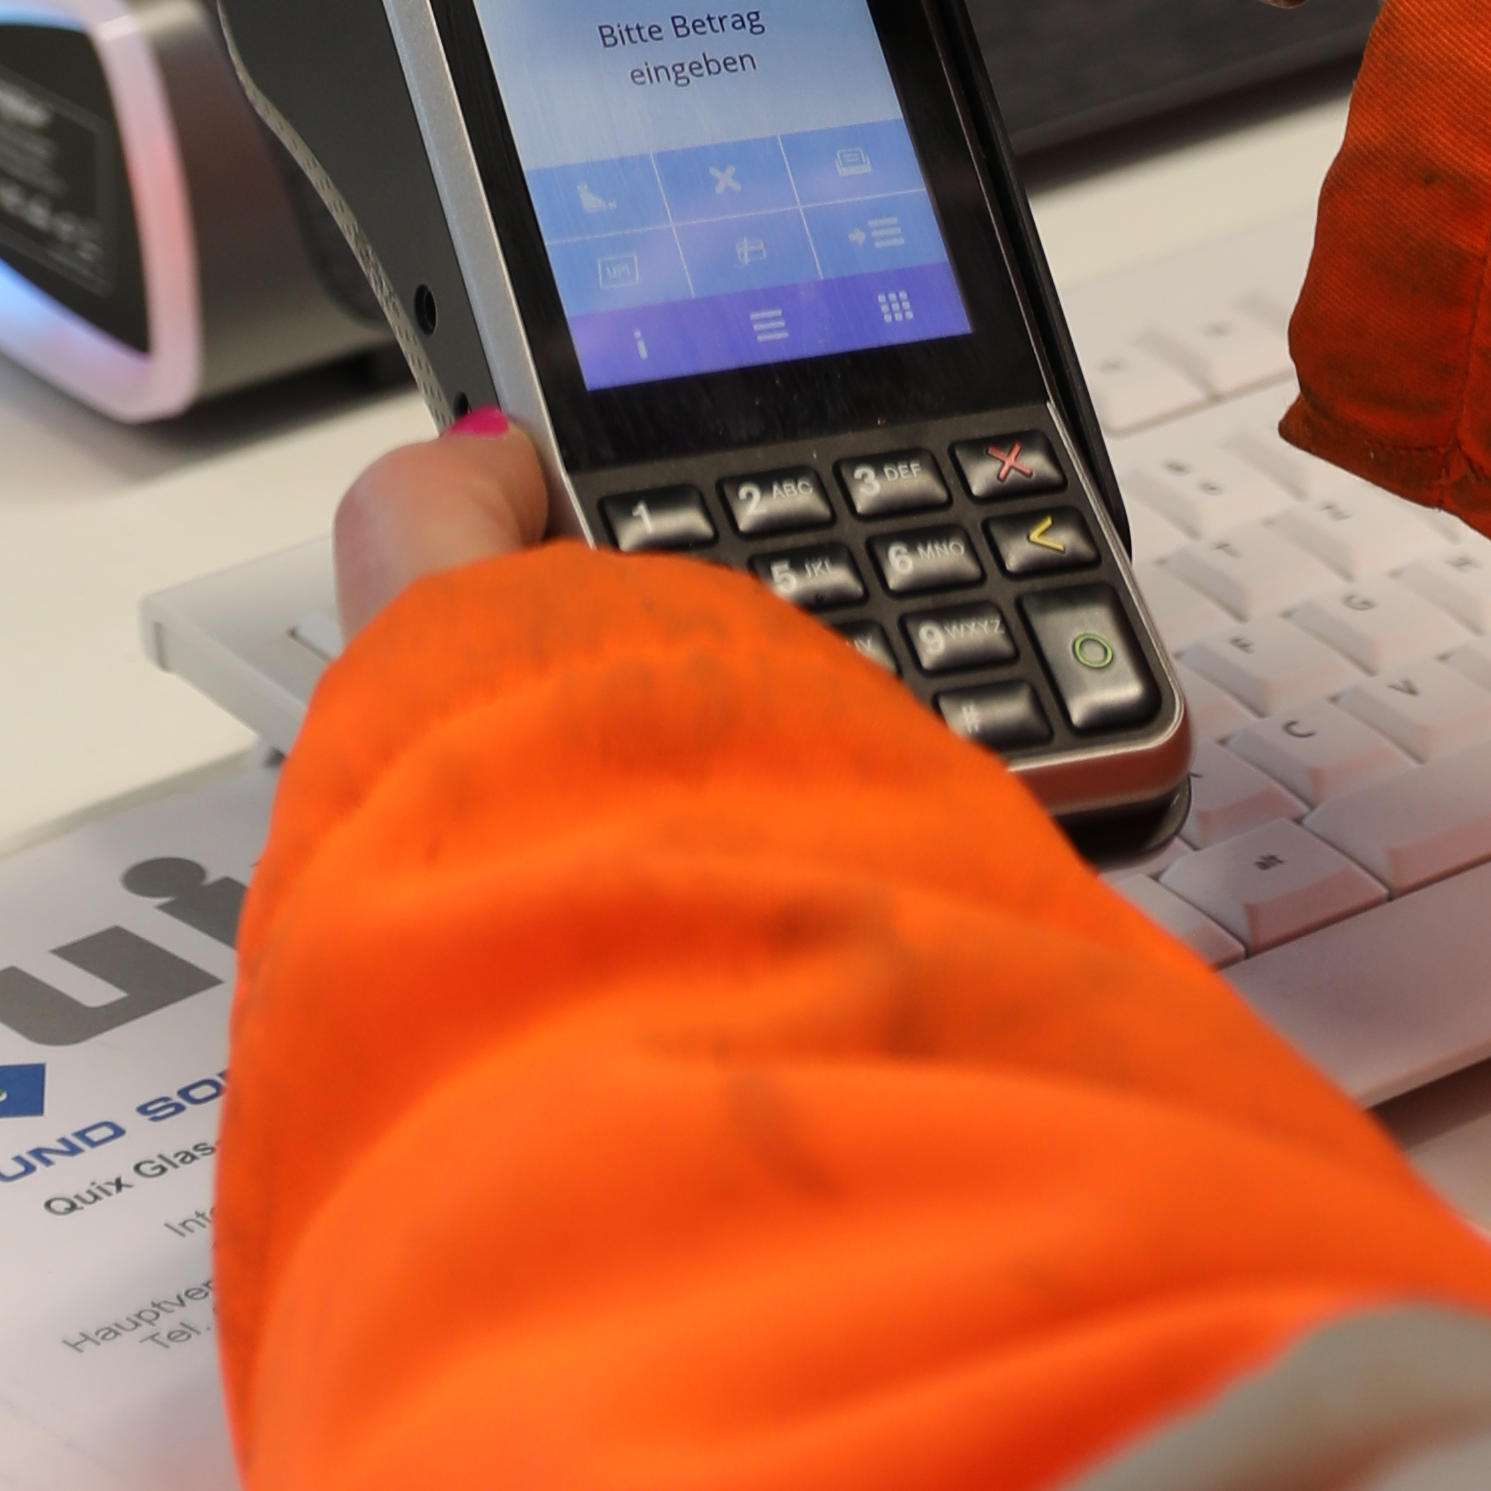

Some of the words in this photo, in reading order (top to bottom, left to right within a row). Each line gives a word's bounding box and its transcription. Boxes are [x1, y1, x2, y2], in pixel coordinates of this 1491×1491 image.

[598, 22, 663, 48] Bitte
[671, 10, 766, 39] Betrag
[630, 51, 757, 88] eingeben
[853, 463, 881, 496] 3
[882, 461, 922, 482] DEF
[738, 483, 767, 516] 2
[771, 479, 814, 500] ABC
[631, 500, 654, 534] 1
[887, 541, 914, 574] 6
[917, 541, 965, 560] MNO
[770, 559, 797, 595] 5
[918, 620, 945, 655] 9
[944, 619, 1005, 639] WXYZ
[135, 1069, 229, 1122] SO
[43, 1175, 134, 1216] Quix
[164, 1206, 215, 1238] Int
